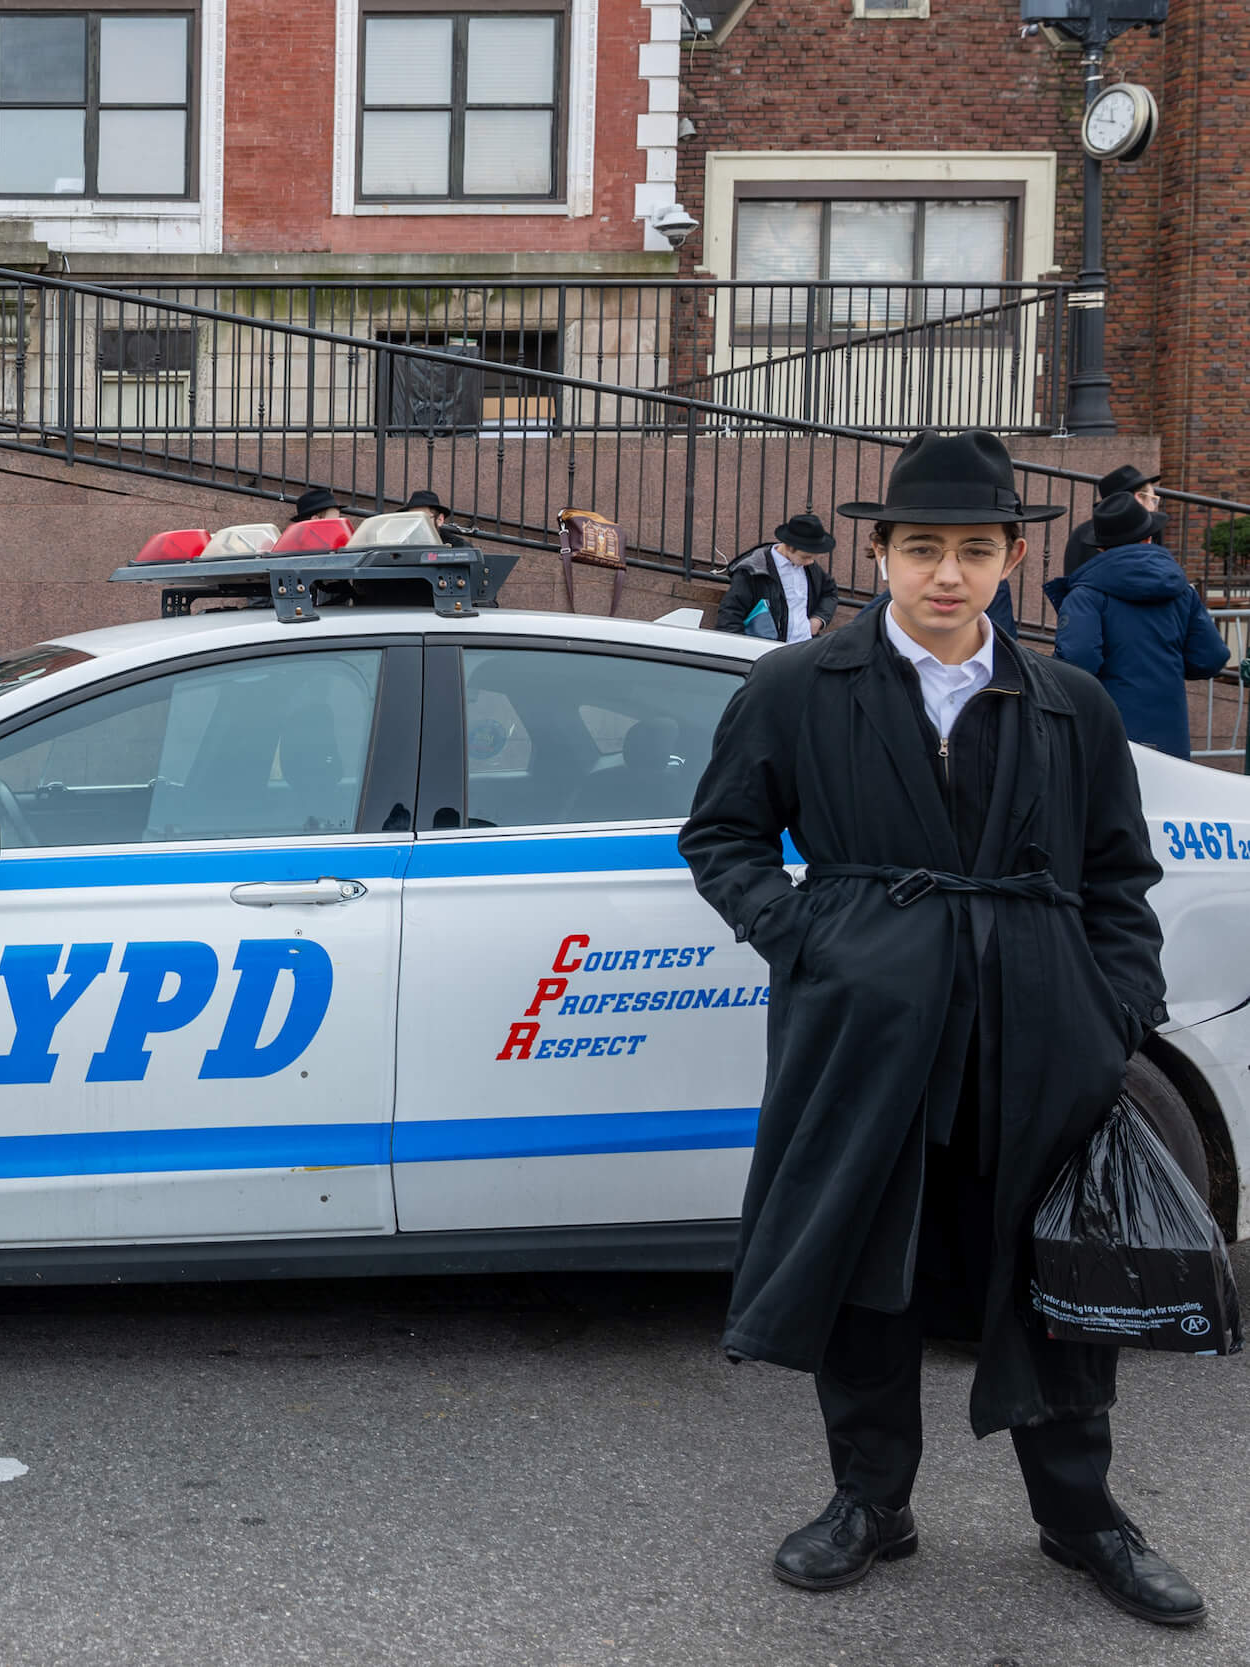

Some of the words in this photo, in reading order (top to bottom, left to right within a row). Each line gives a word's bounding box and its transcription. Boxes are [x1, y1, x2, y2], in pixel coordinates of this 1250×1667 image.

[1163, 821, 1238, 860] 3467
[1238, 839, 1250, 860] 2
[552, 934, 715, 973] COURTESY
[495, 1022, 647, 1061] RESPECT
